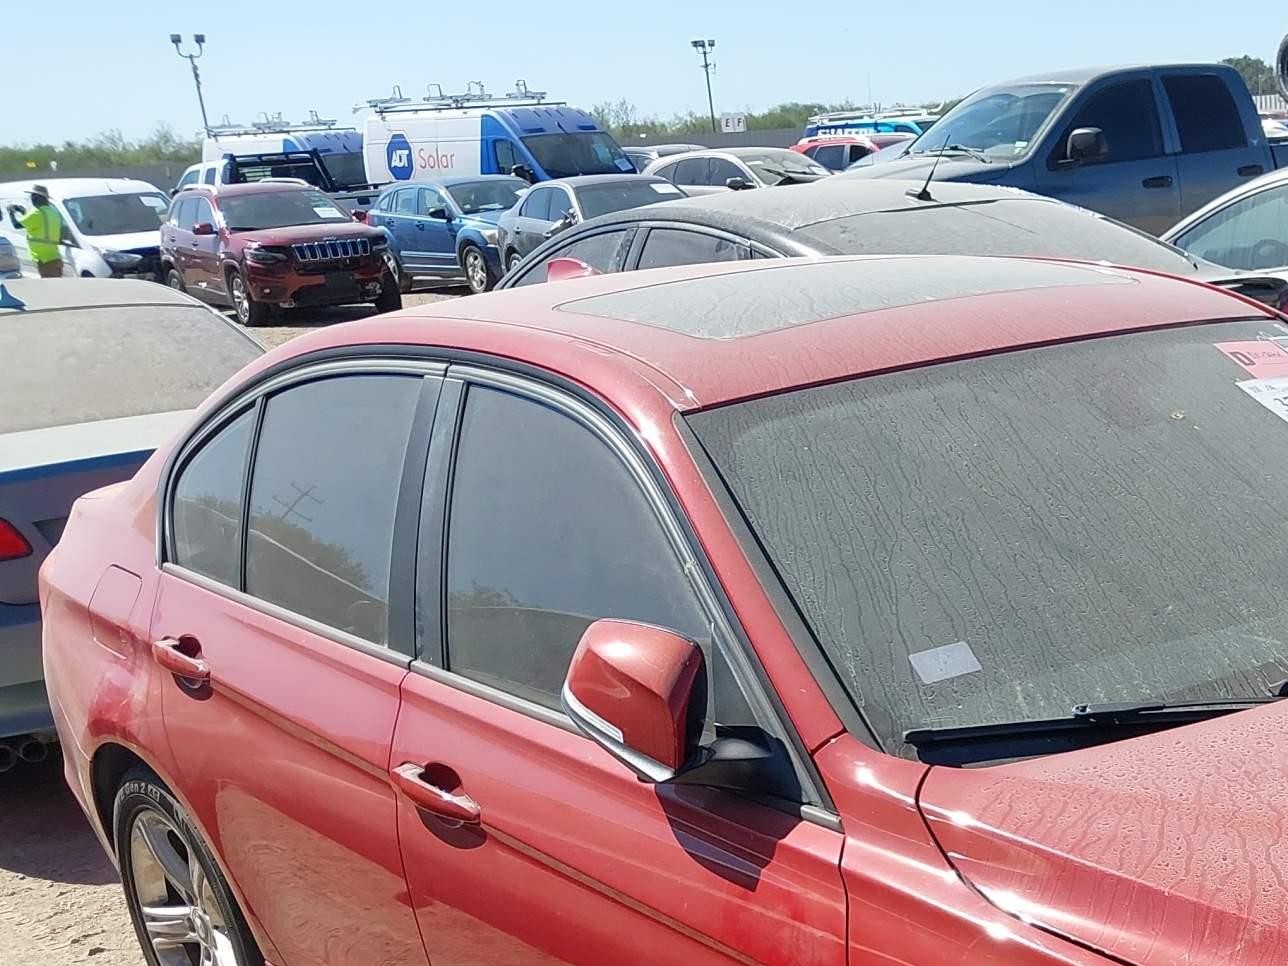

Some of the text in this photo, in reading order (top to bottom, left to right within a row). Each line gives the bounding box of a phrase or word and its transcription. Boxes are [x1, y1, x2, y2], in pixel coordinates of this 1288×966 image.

[725, 117, 743, 128] E F
[390, 145, 455, 169] ADT Solar
[140, 782, 147, 794] 2
